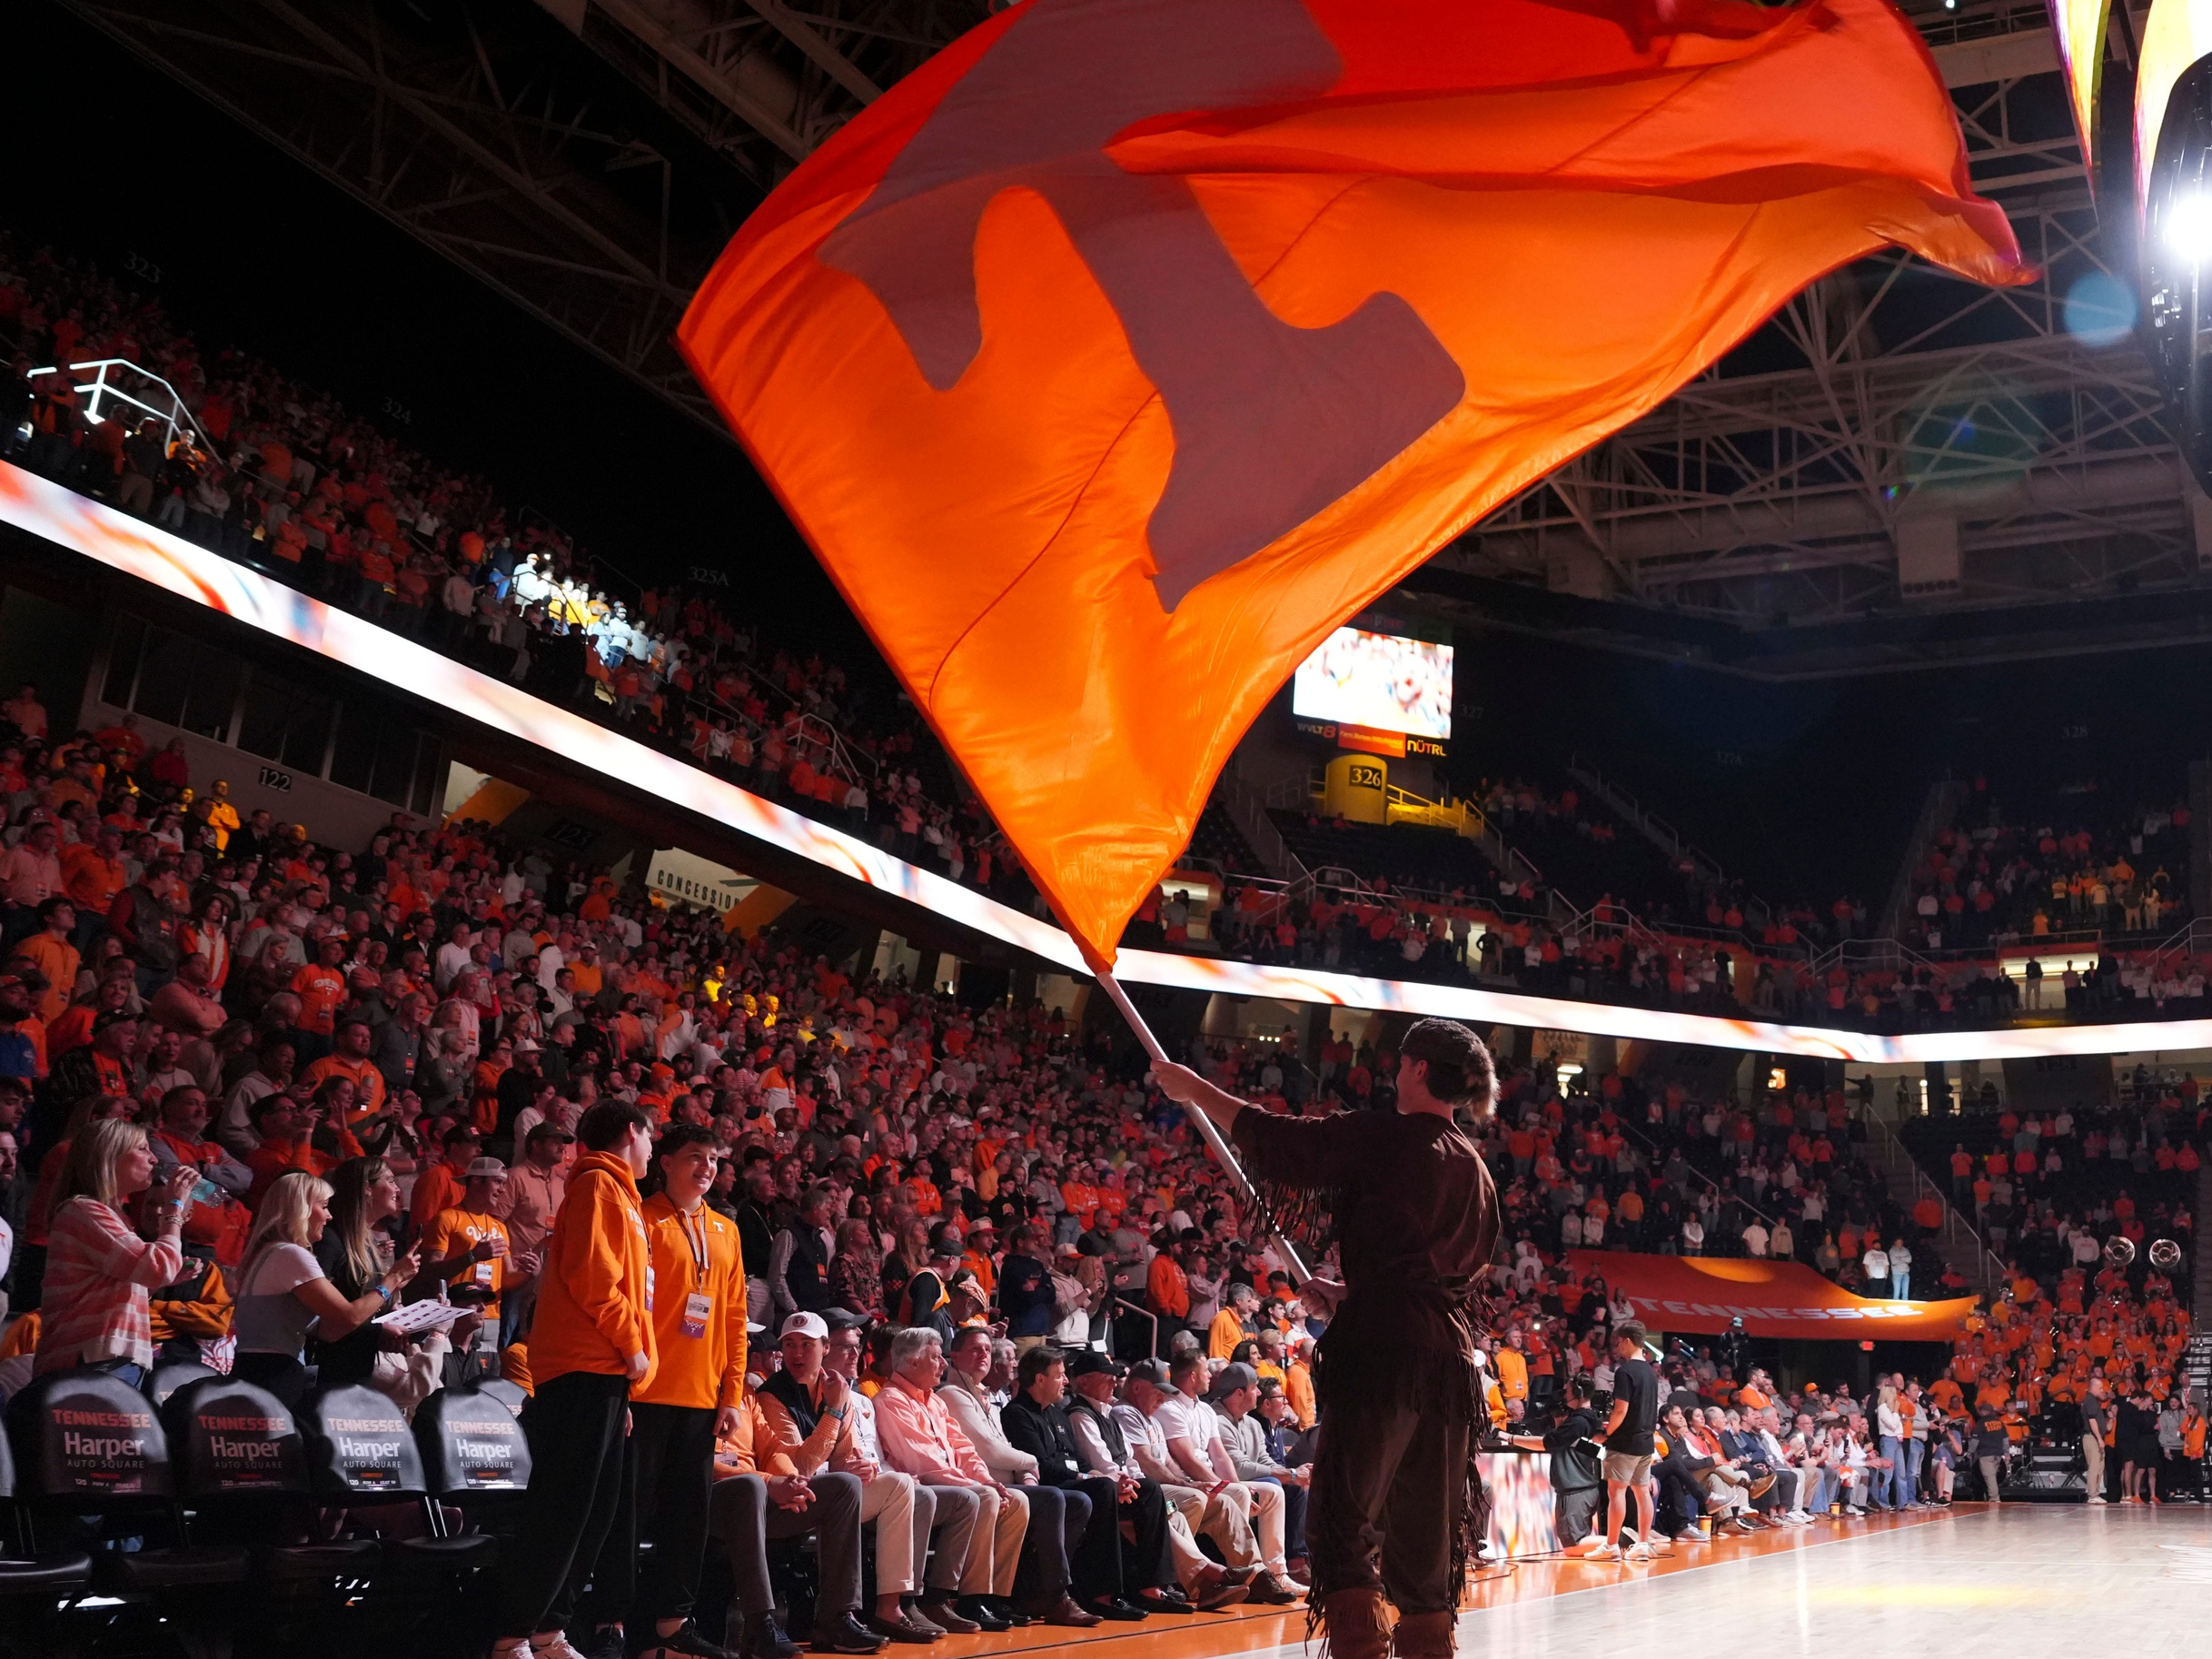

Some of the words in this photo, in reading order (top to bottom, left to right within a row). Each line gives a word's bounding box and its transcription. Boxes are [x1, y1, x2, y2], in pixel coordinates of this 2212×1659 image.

[124, 251, 162, 283] 323
[382, 396, 412, 424] 324
[689, 566, 730, 587] 325A
[261, 769, 291, 792] 122
[1351, 768, 1381, 787] 326
[1629, 1296, 1924, 1320] TENNESSEE
[52, 1408, 152, 1428] TENNESSEE
[197, 1415, 286, 1432] TENNESSEE
[328, 1417, 405, 1433] TENNESSEE
[445, 1420, 515, 1435] TENNESSEE
[64, 1431, 144, 1461] Harper
[210, 1435, 282, 1462] Harper
[339, 1436, 401, 1461] Harper
[456, 1438, 512, 1462] Harper
[67, 1459, 96, 1468] AUTO
[102, 1459, 145, 1469] SQUARE
[214, 1460, 241, 1470] AUTO
[244, 1460, 283, 1470] SQUARE
[342, 1460, 366, 1468] AUTO
[370, 1460, 402, 1469] SQUARE
[484, 1461, 514, 1469] SQUARE
[74, 1477, 87, 1486] 120
